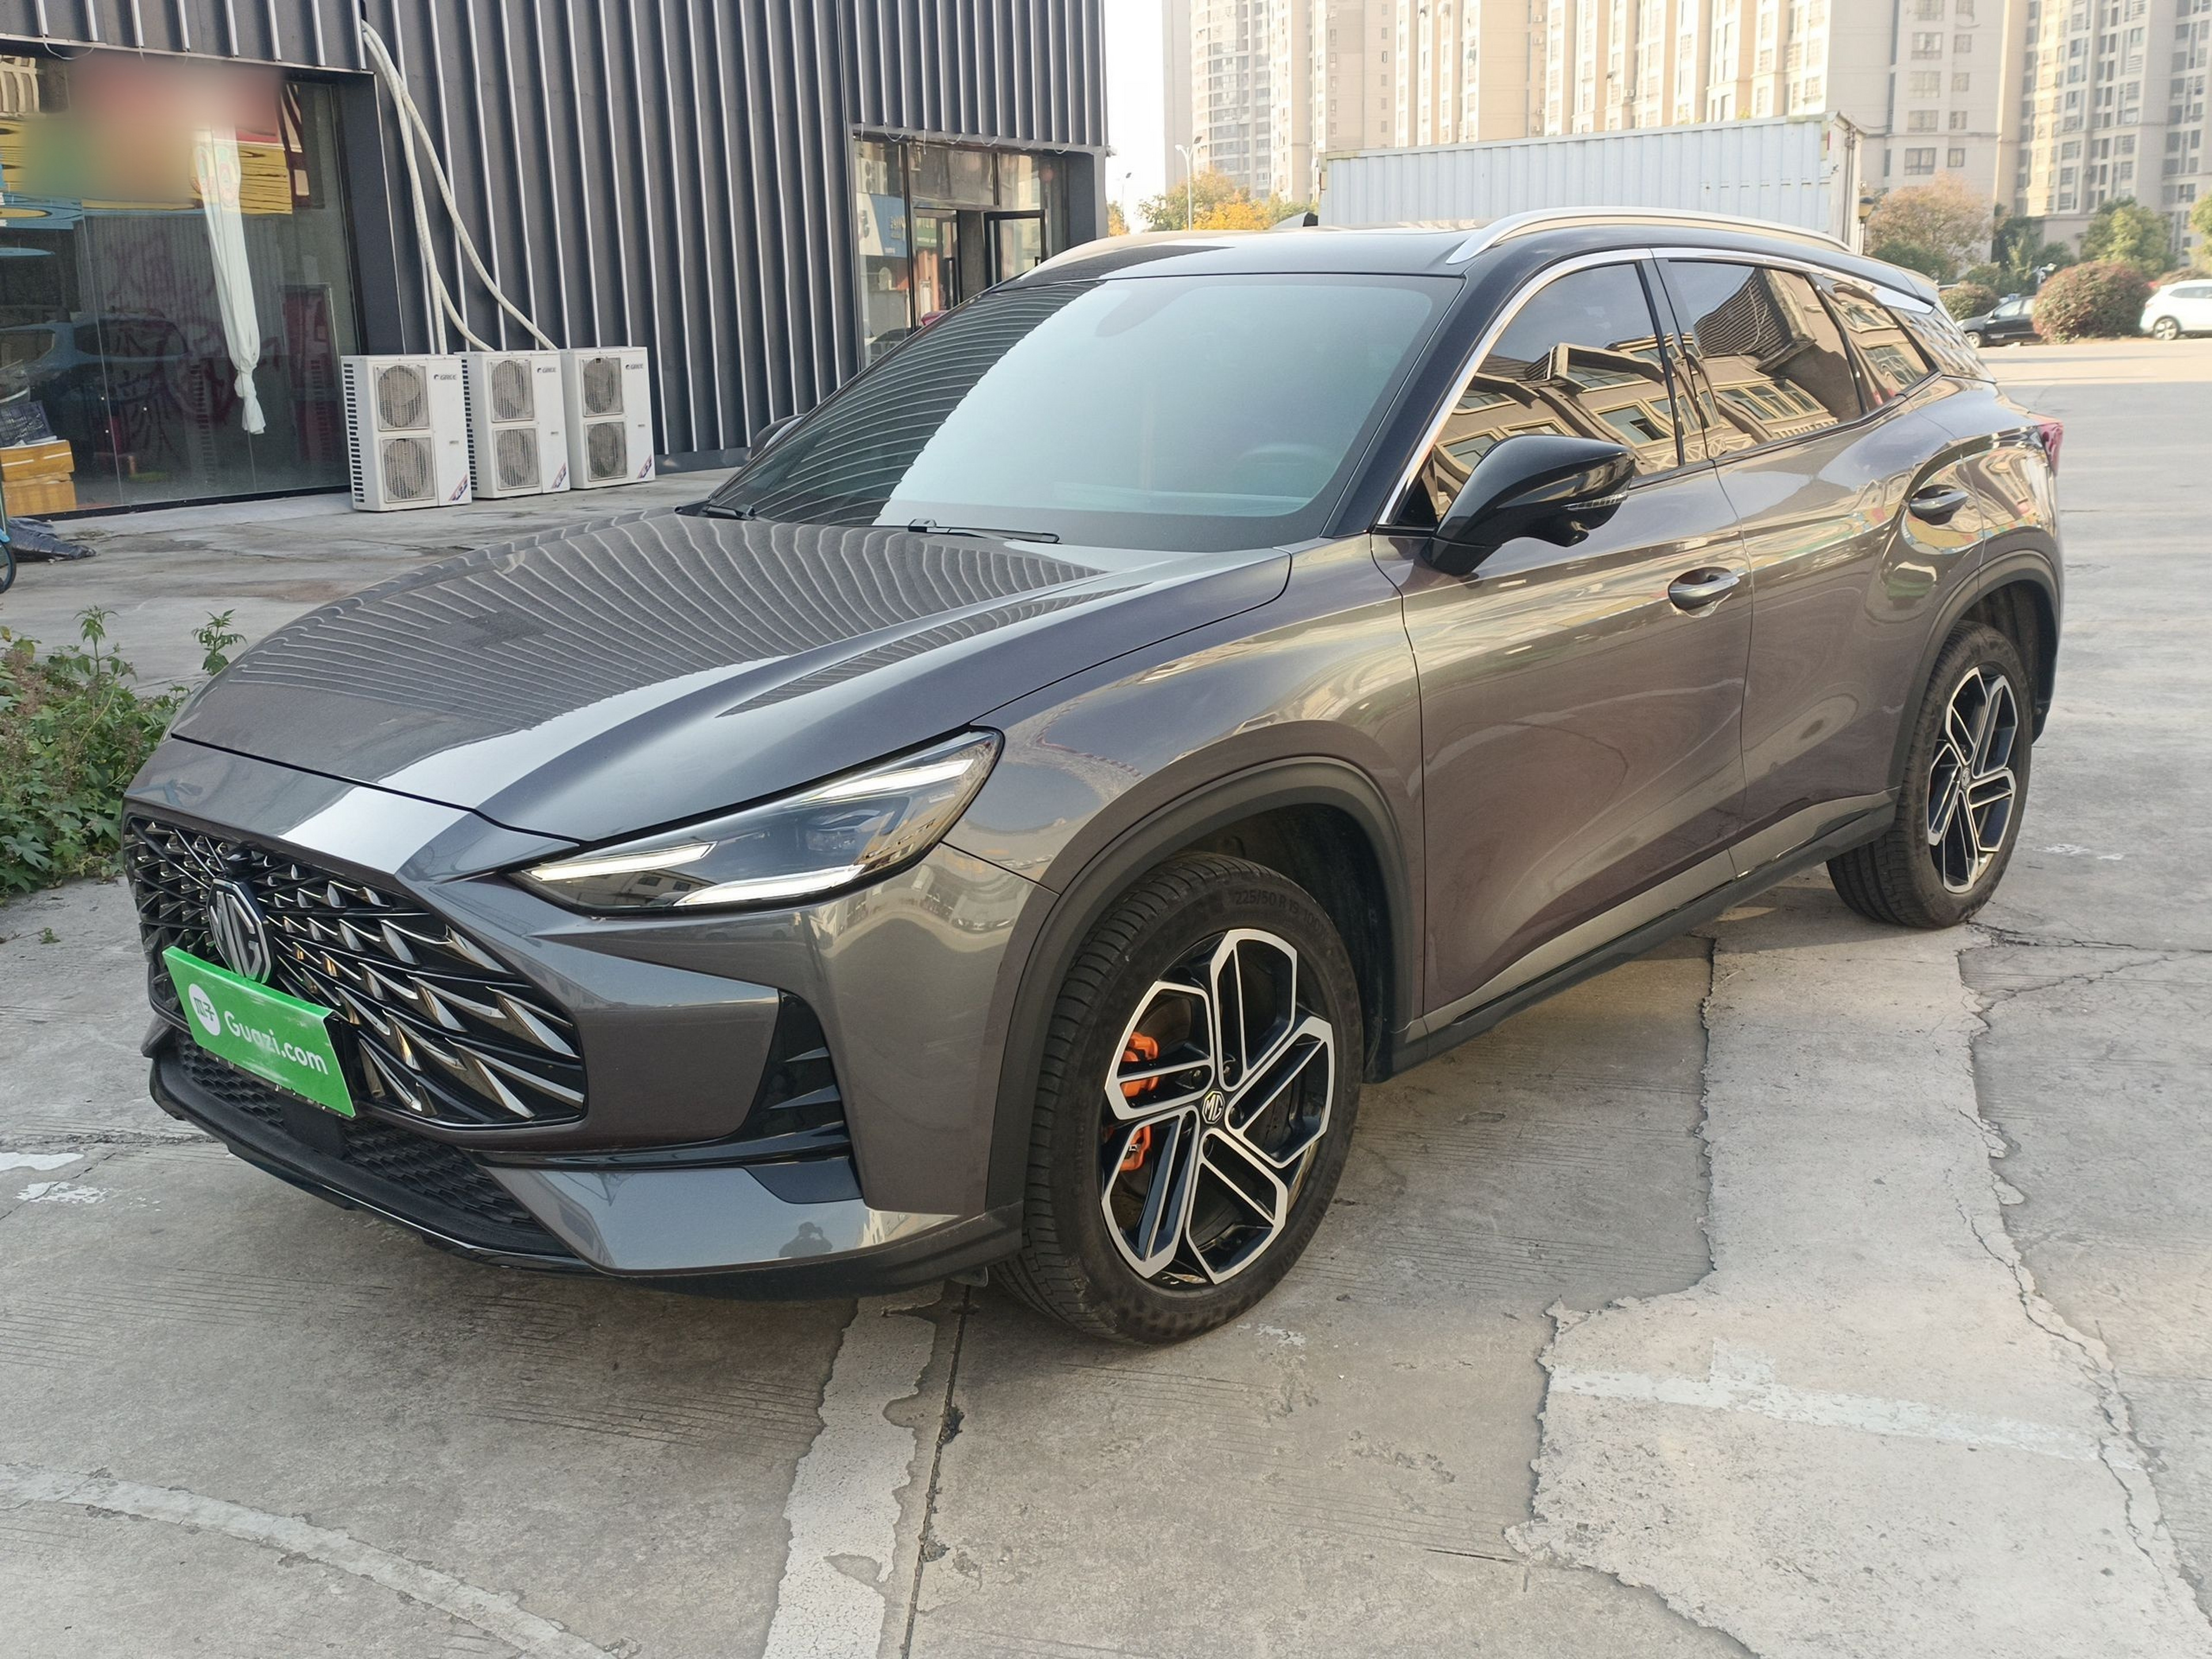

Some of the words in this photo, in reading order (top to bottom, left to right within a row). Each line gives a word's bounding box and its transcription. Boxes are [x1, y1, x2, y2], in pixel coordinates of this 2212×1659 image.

[210, 890, 262, 980] MG
[224, 1010, 329, 1075] Guazi.com
[1205, 1094, 1223, 1121] MG
